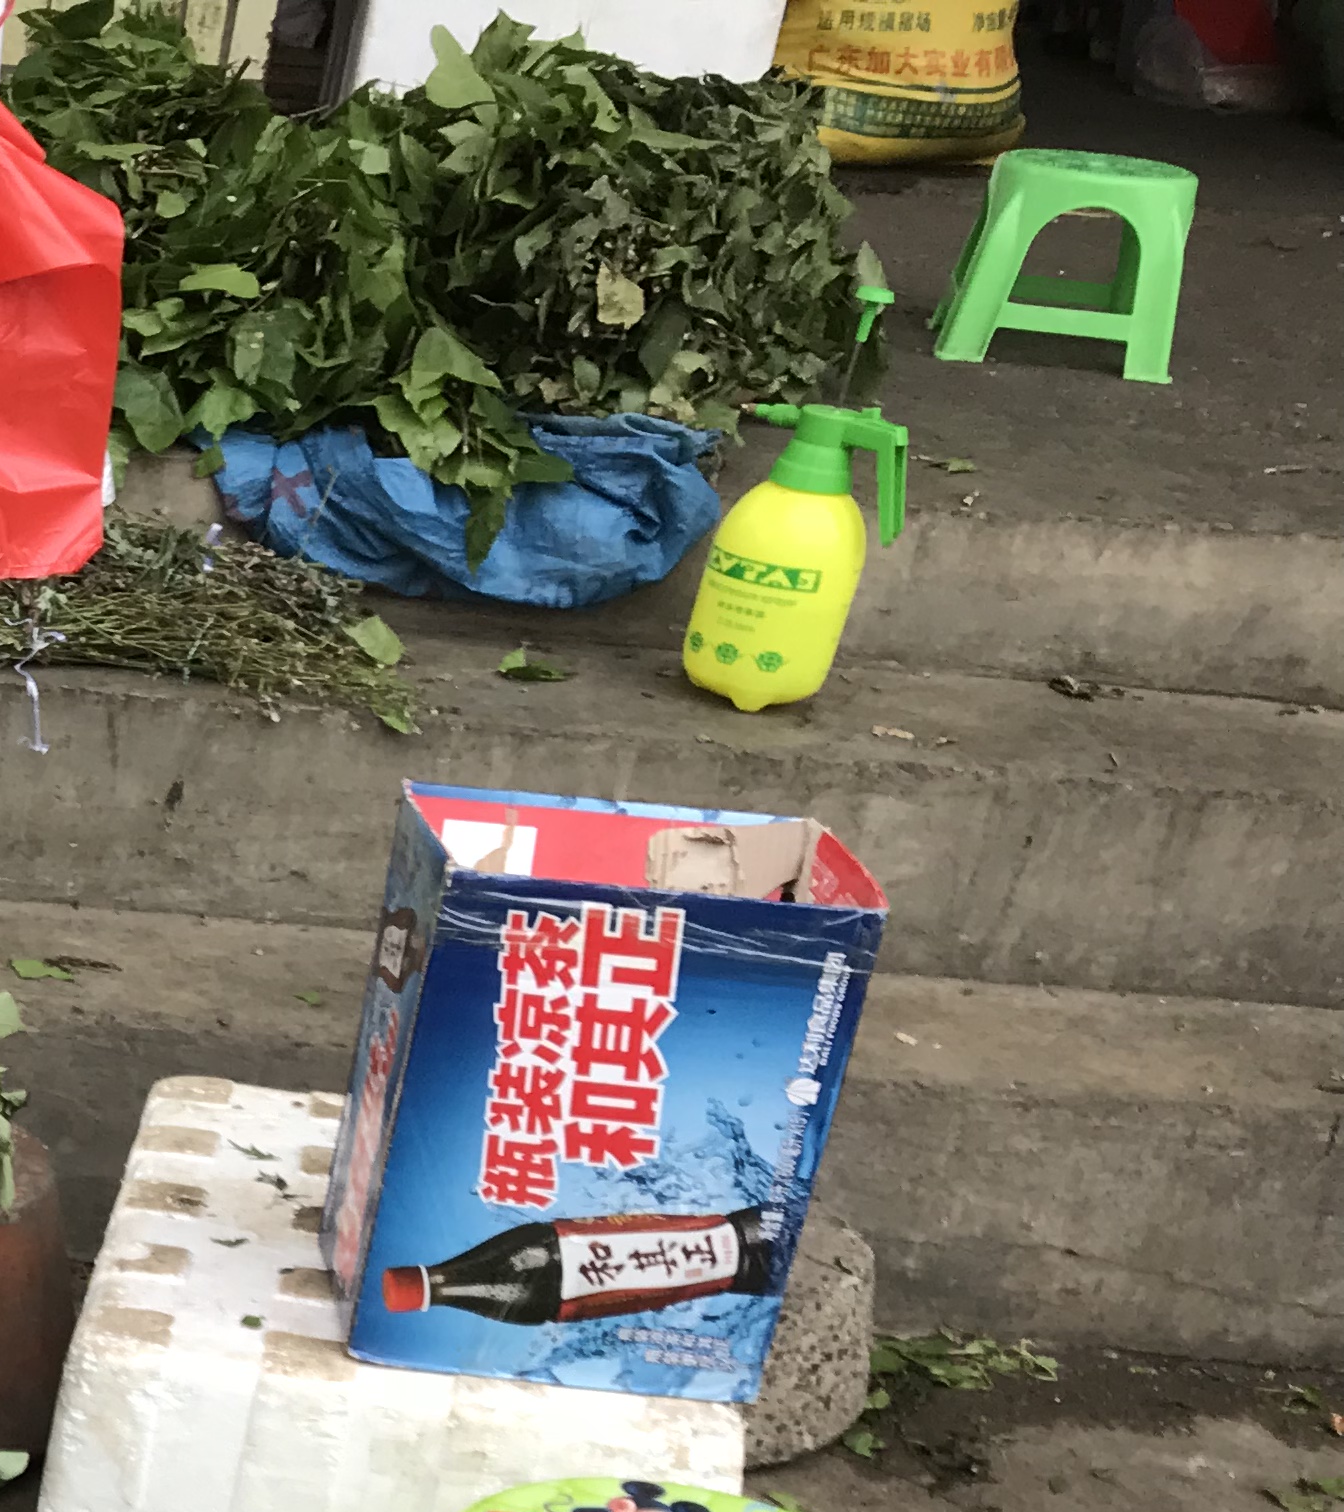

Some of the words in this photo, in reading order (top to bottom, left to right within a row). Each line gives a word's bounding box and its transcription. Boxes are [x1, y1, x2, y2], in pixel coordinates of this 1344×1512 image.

[477, 909, 581, 1211] 瓶装凉茶
[561, 901, 685, 1170] 和其正
[579, 1235, 717, 1286] 和其正
